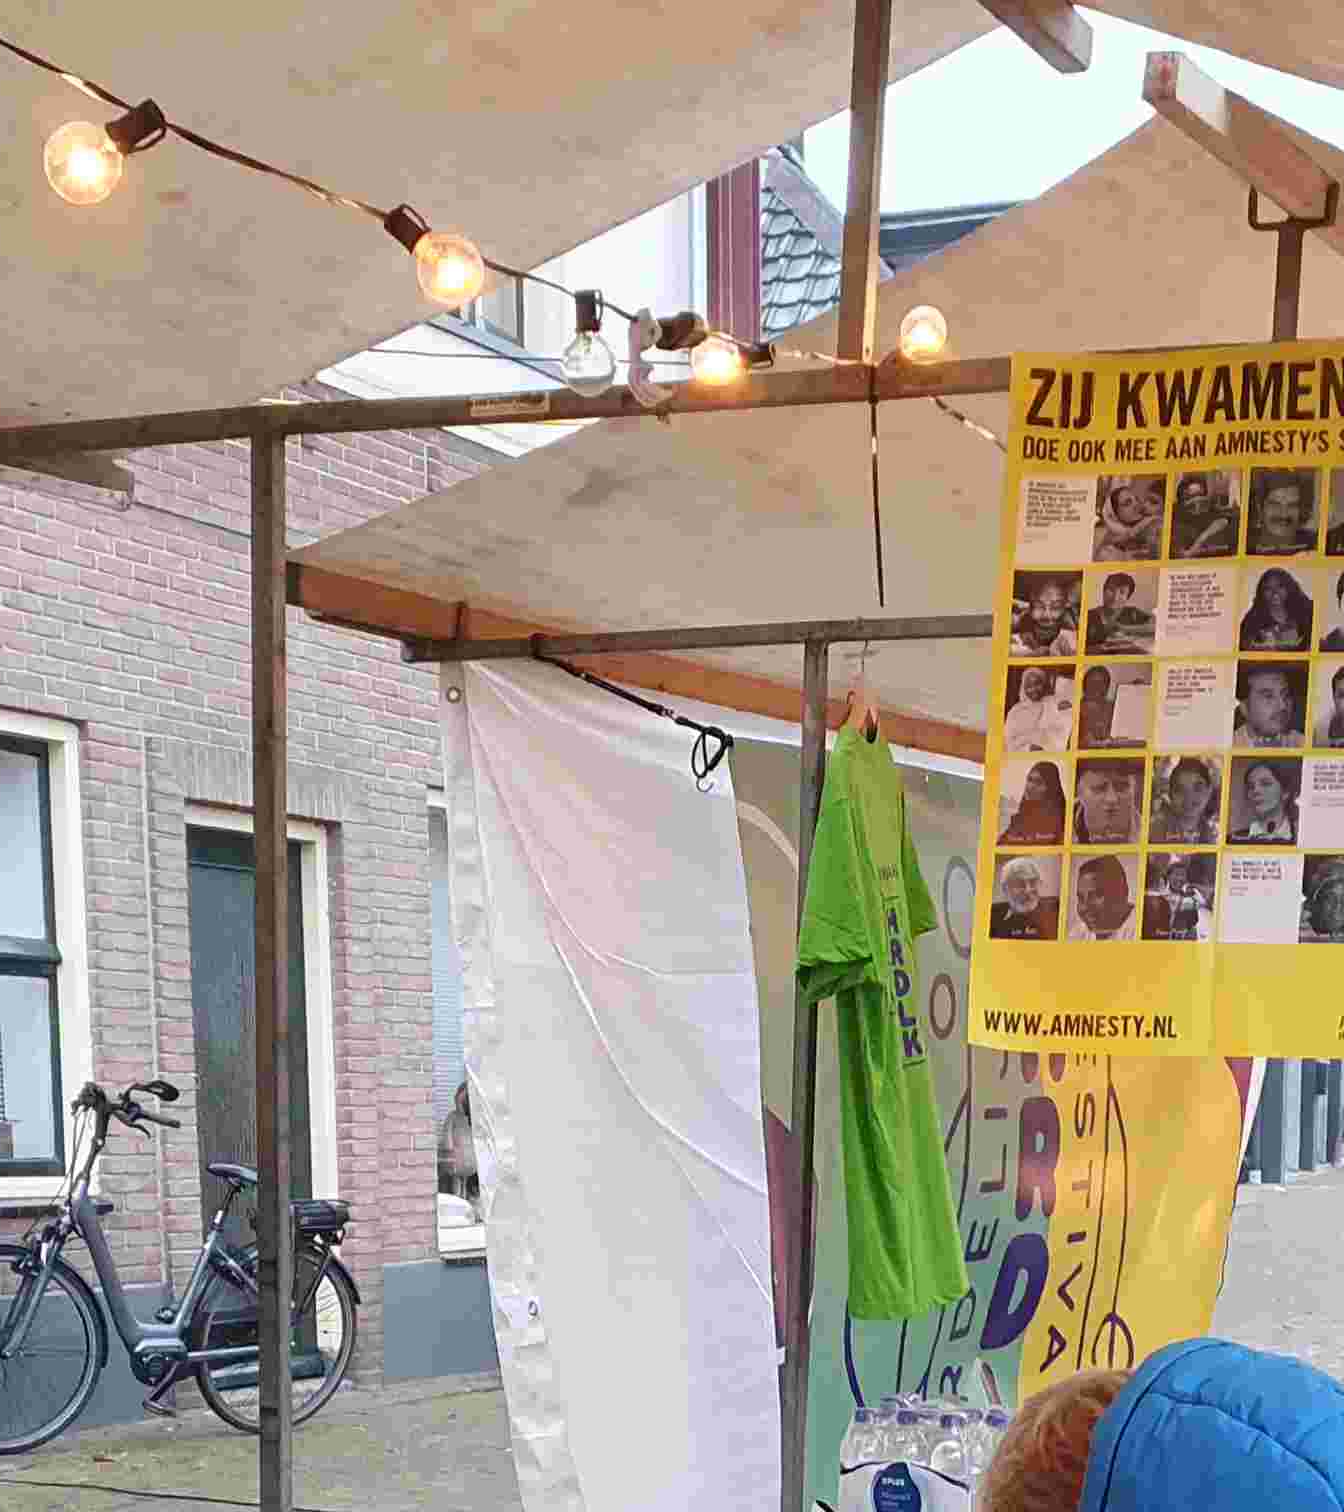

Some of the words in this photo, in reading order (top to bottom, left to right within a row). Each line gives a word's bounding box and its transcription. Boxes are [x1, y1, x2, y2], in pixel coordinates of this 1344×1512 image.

[1025, 367, 1095, 430] ZIJ
[1022, 435, 1059, 462] DOE
[1068, 437, 1105, 463] OOK
[1115, 436, 1156, 461] MEE
[1165, 433, 1206, 459] AAN
[1214, 428, 1330, 456] AMNESTY'S
[983, 1009, 1177, 1039] WWW.AMNESTY.NL
